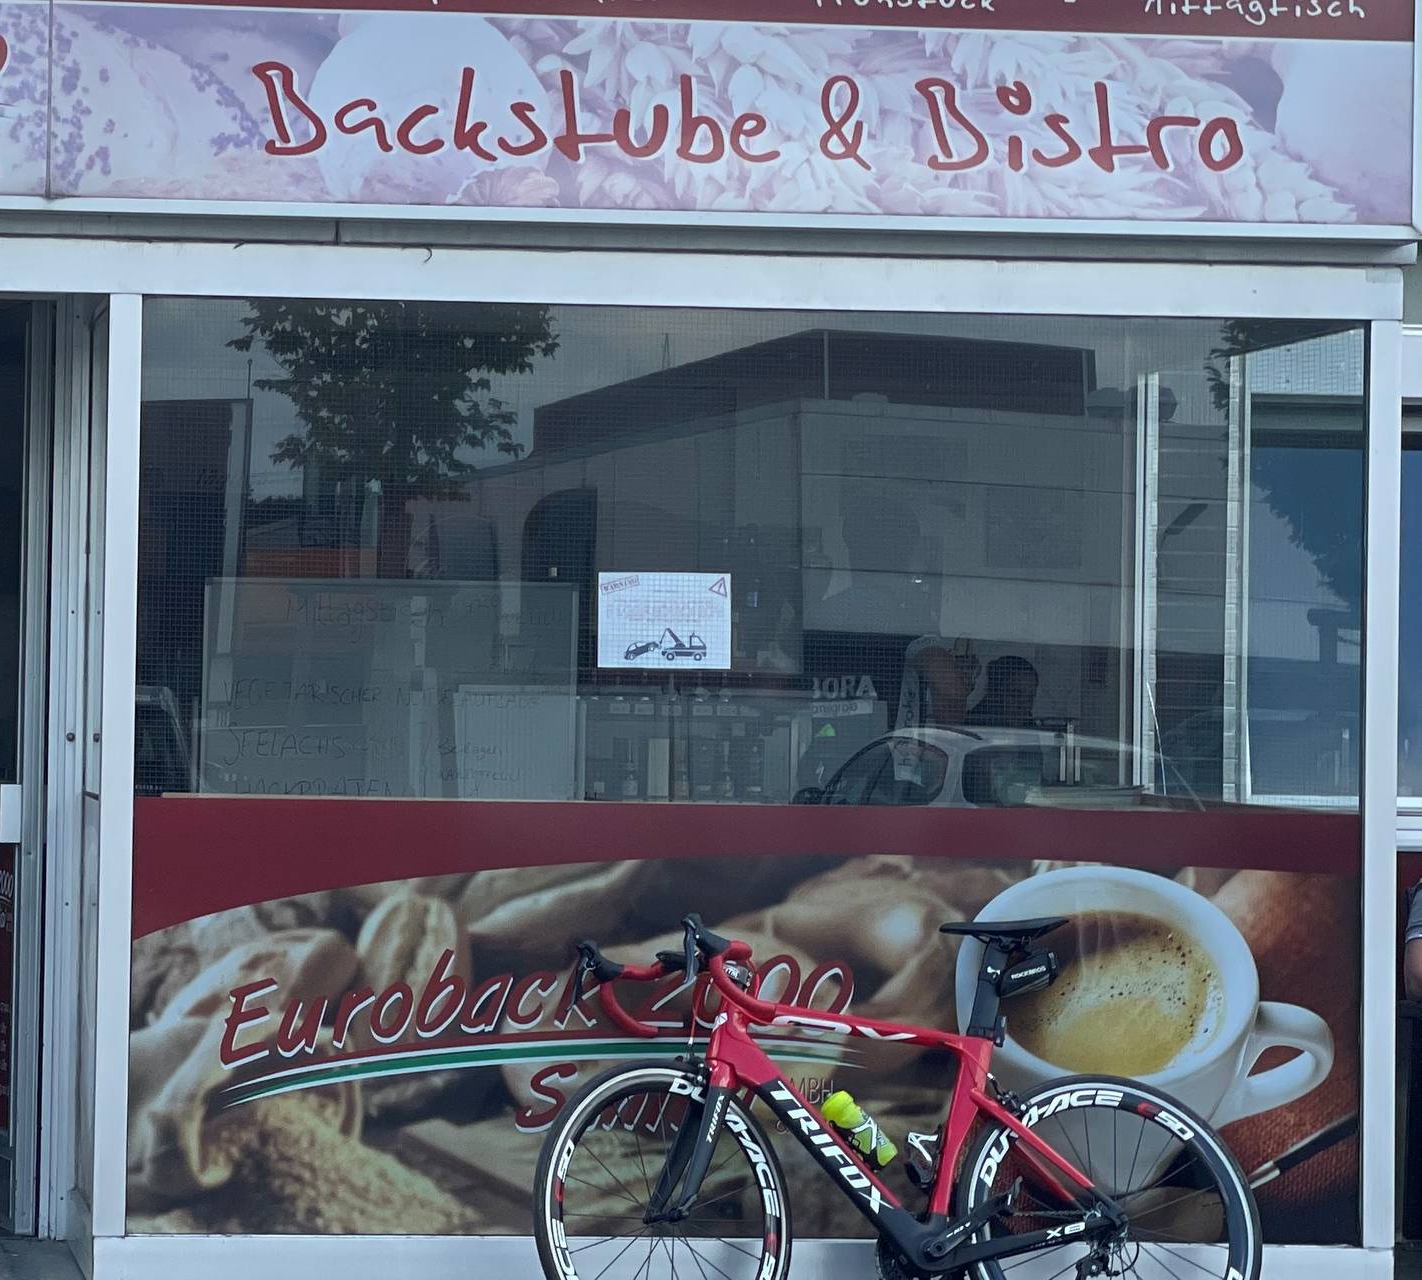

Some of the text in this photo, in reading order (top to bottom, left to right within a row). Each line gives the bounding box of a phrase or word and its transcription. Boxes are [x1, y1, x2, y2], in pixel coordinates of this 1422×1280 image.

[252, 62, 1243, 172] Backstube & Bistro
[219, 949, 599, 1070] Euroback
[770, 1080, 895, 1215] TRIFOX
